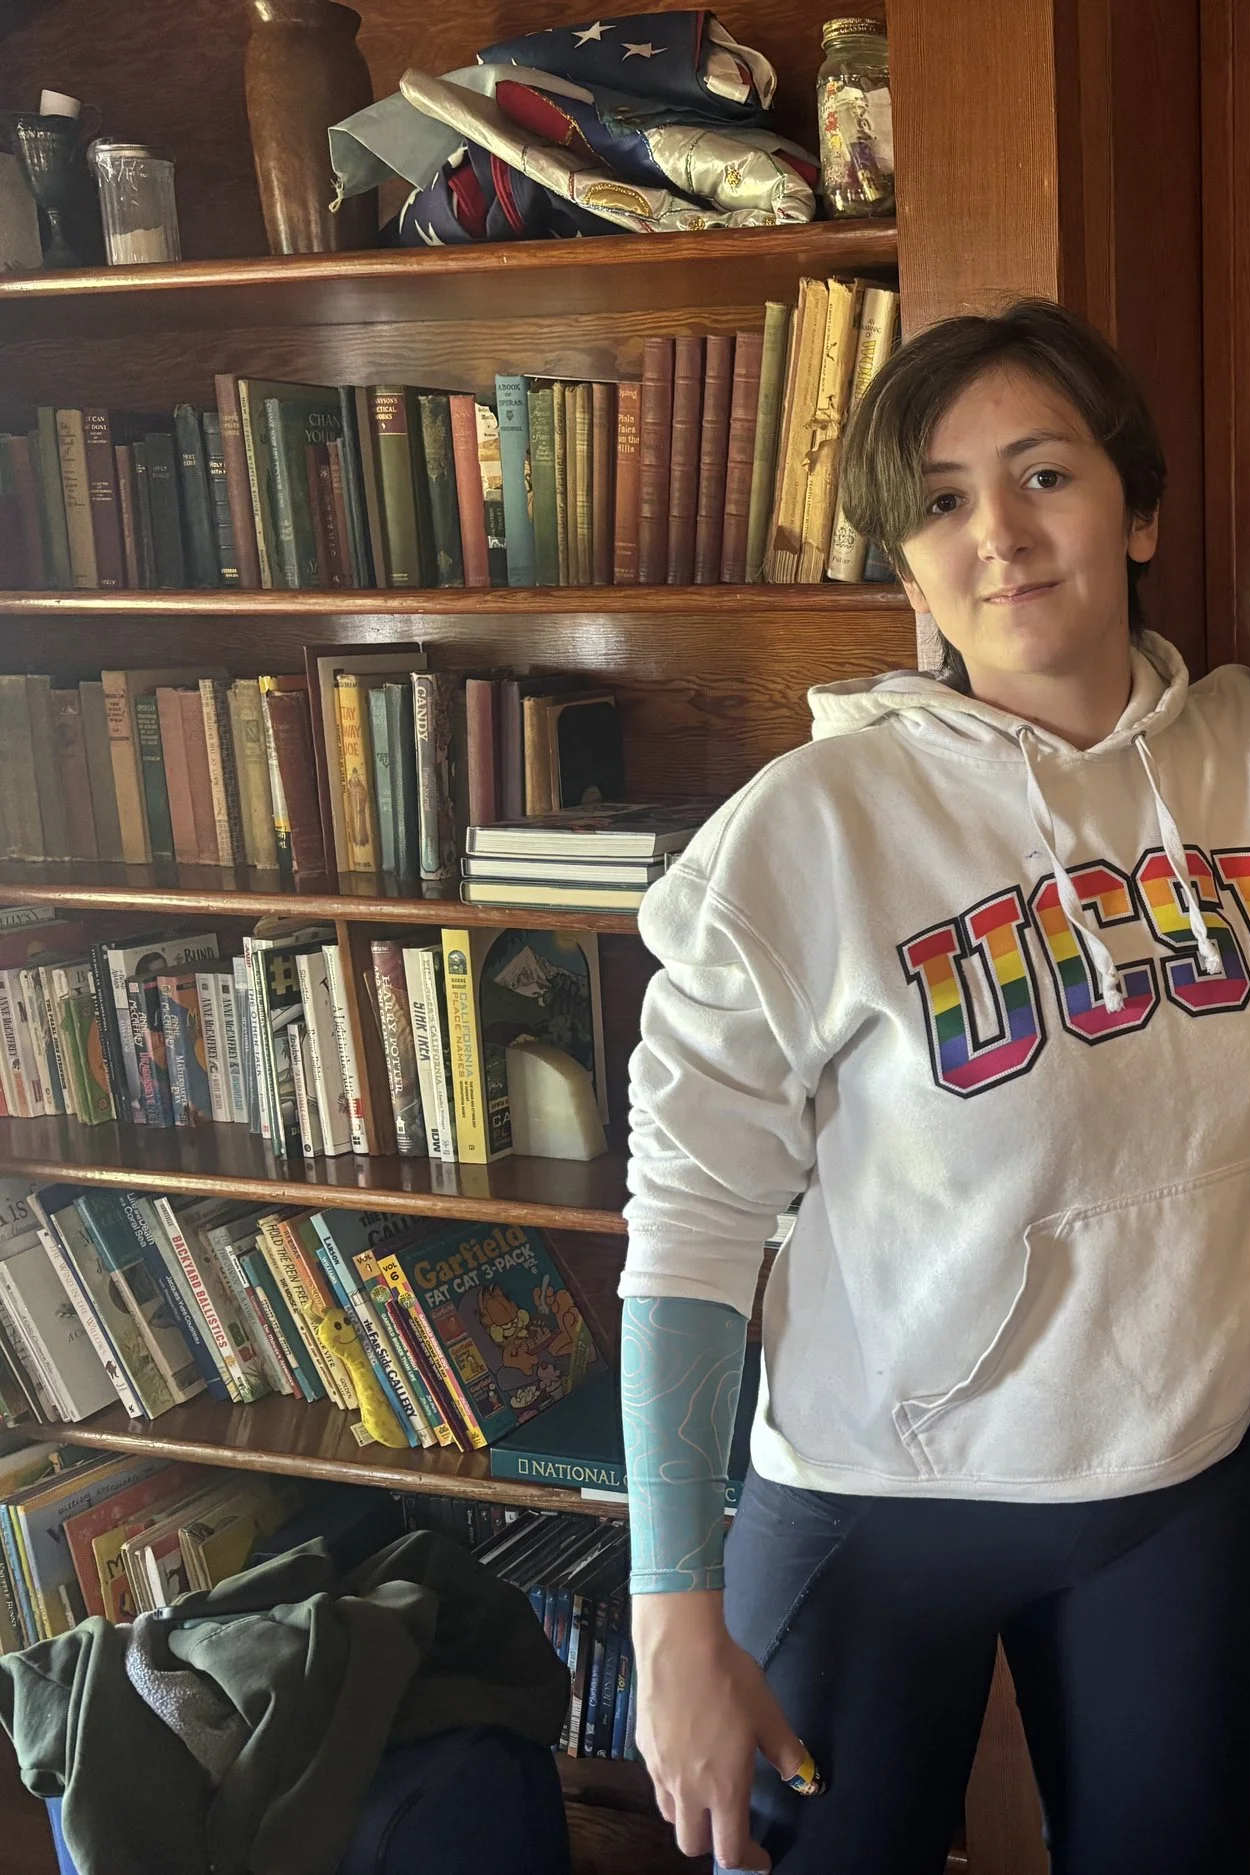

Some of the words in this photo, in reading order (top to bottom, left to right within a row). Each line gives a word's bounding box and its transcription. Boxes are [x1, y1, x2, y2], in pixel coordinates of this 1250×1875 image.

[416, 686, 429, 743] CANDY
[48, 1011, 57, 1031] PEARL
[202, 997, 212, 1018] ANNE
[222, 997, 232, 1018] ANNE
[452, 991, 462, 1030] PLACE
[139, 1012, 149, 1033] ANNE
[334, 1016, 347, 1042] Light
[381, 975, 397, 1035] HARRY
[389, 1039, 404, 1093] POTTER
[459, 992, 474, 1079] CALIFORNIA
[430, 1025, 441, 1085] CALIFORNIA
[456, 1036, 466, 1078] NAMES
[431, 1129, 441, 1153] IDW
[124, 1206, 141, 1233] Coral
[134, 1230, 148, 1249] Sea
[138, 1217, 155, 1246] Death
[266, 1224, 284, 1246] HOLD
[278, 1245, 291, 1261] THE
[323, 1236, 341, 1266] LARSON
[414, 1224, 528, 1290] Garfield
[521, 1258, 539, 1270] VOL
[284, 1258, 301, 1283] REIN
[382, 1262, 398, 1273] VOL
[390, 1271, 400, 1281] 6
[424, 1283, 450, 1308] FAT
[453, 1268, 480, 1294] CAT
[481, 1243, 535, 1280] 3-PACK
[49, 1244, 60, 1259] THE
[60, 1262, 74, 1288] WIND
[86, 1316, 107, 1356] WILLOWS
[172, 1234, 203, 1289] BACKYARD
[195, 1289, 229, 1349] BALLISTICS
[284, 1288, 296, 1308] MOUSE
[183, 1314, 201, 1346] Cousteau
[377, 1347, 391, 1374] Side
[388, 1368, 418, 1418] GALLERY
[531, 1460, 620, 1487] NATIONAL
[617, 1674, 626, 1693] TOY
